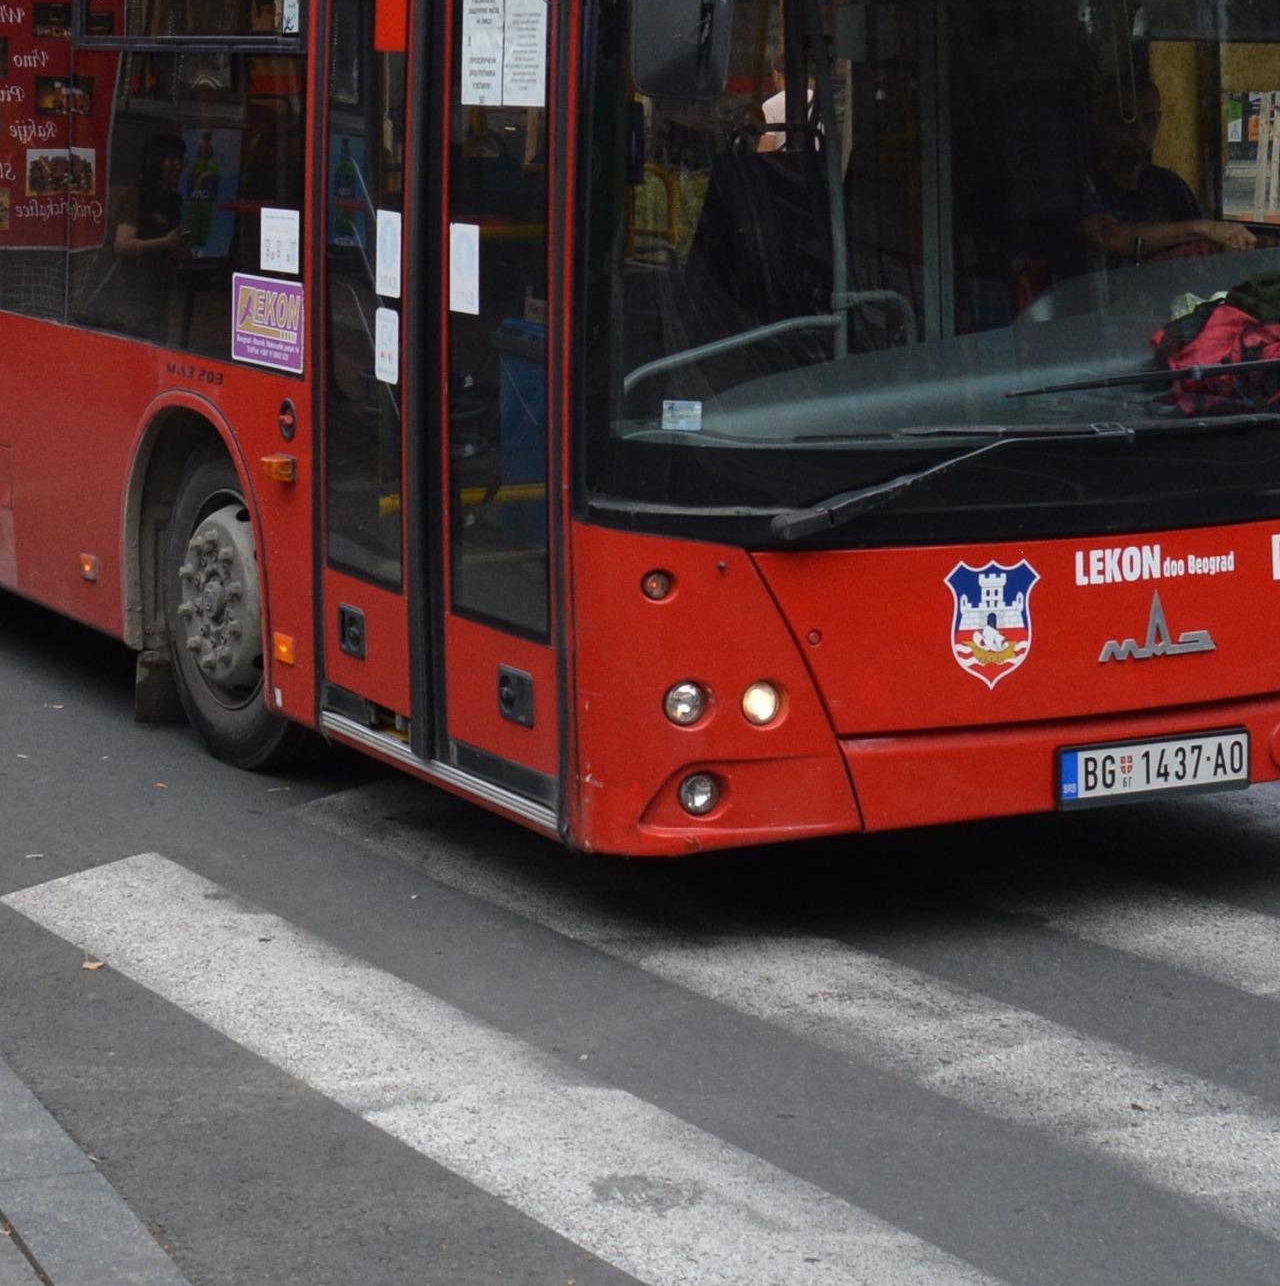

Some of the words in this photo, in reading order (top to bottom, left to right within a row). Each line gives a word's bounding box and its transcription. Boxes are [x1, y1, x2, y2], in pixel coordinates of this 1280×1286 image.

[1075, 544, 1161, 586] LEKON
[1163, 557, 1185, 577] doo
[1187, 551, 1235, 575] Beograd
[1083, 754, 1116, 792] BG
